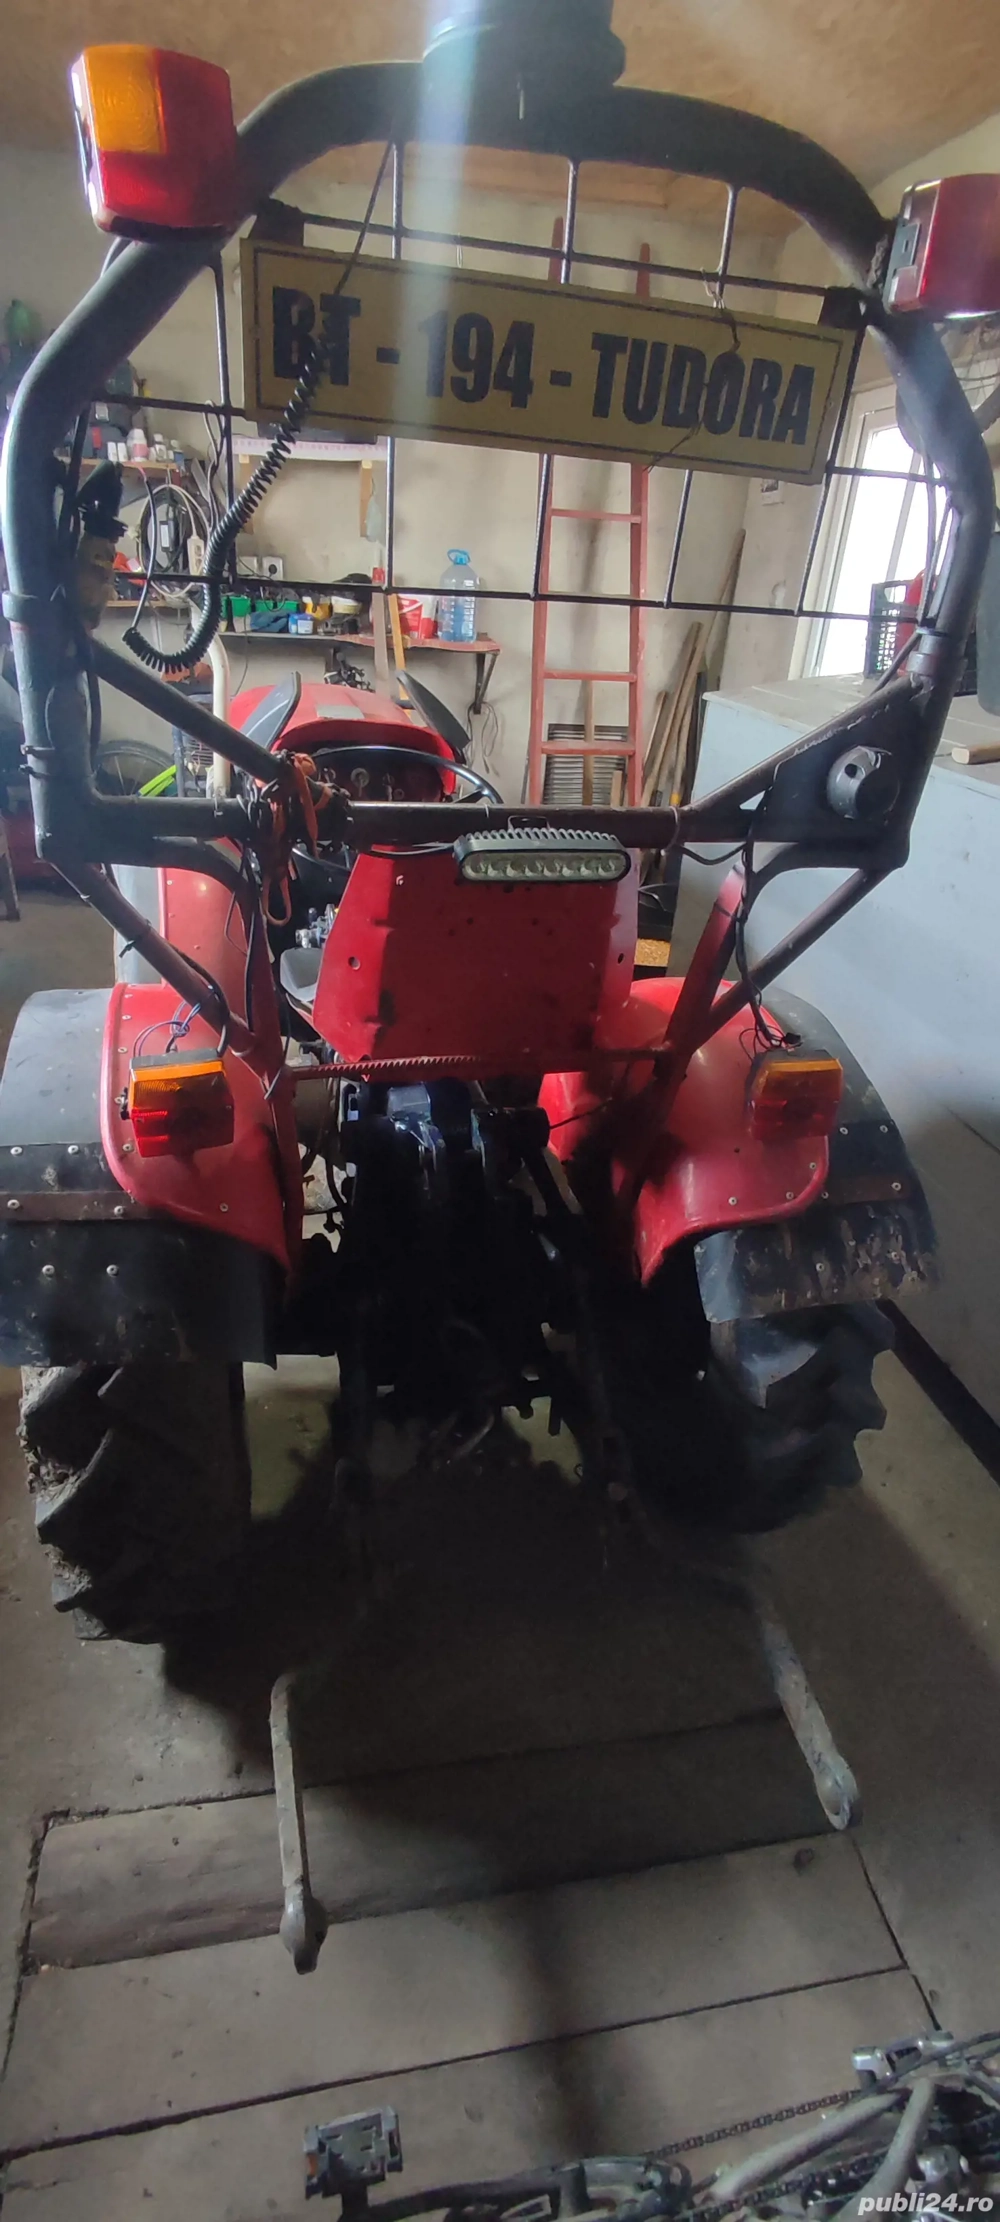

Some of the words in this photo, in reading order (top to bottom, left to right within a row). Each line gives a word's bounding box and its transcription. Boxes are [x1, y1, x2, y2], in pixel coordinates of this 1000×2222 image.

[272, 287, 360, 385] BT
[376, 347, 400, 364] -
[418, 311, 534, 408] 194
[549, 370, 572, 386] -
[591, 332, 815, 445] TUDORA
